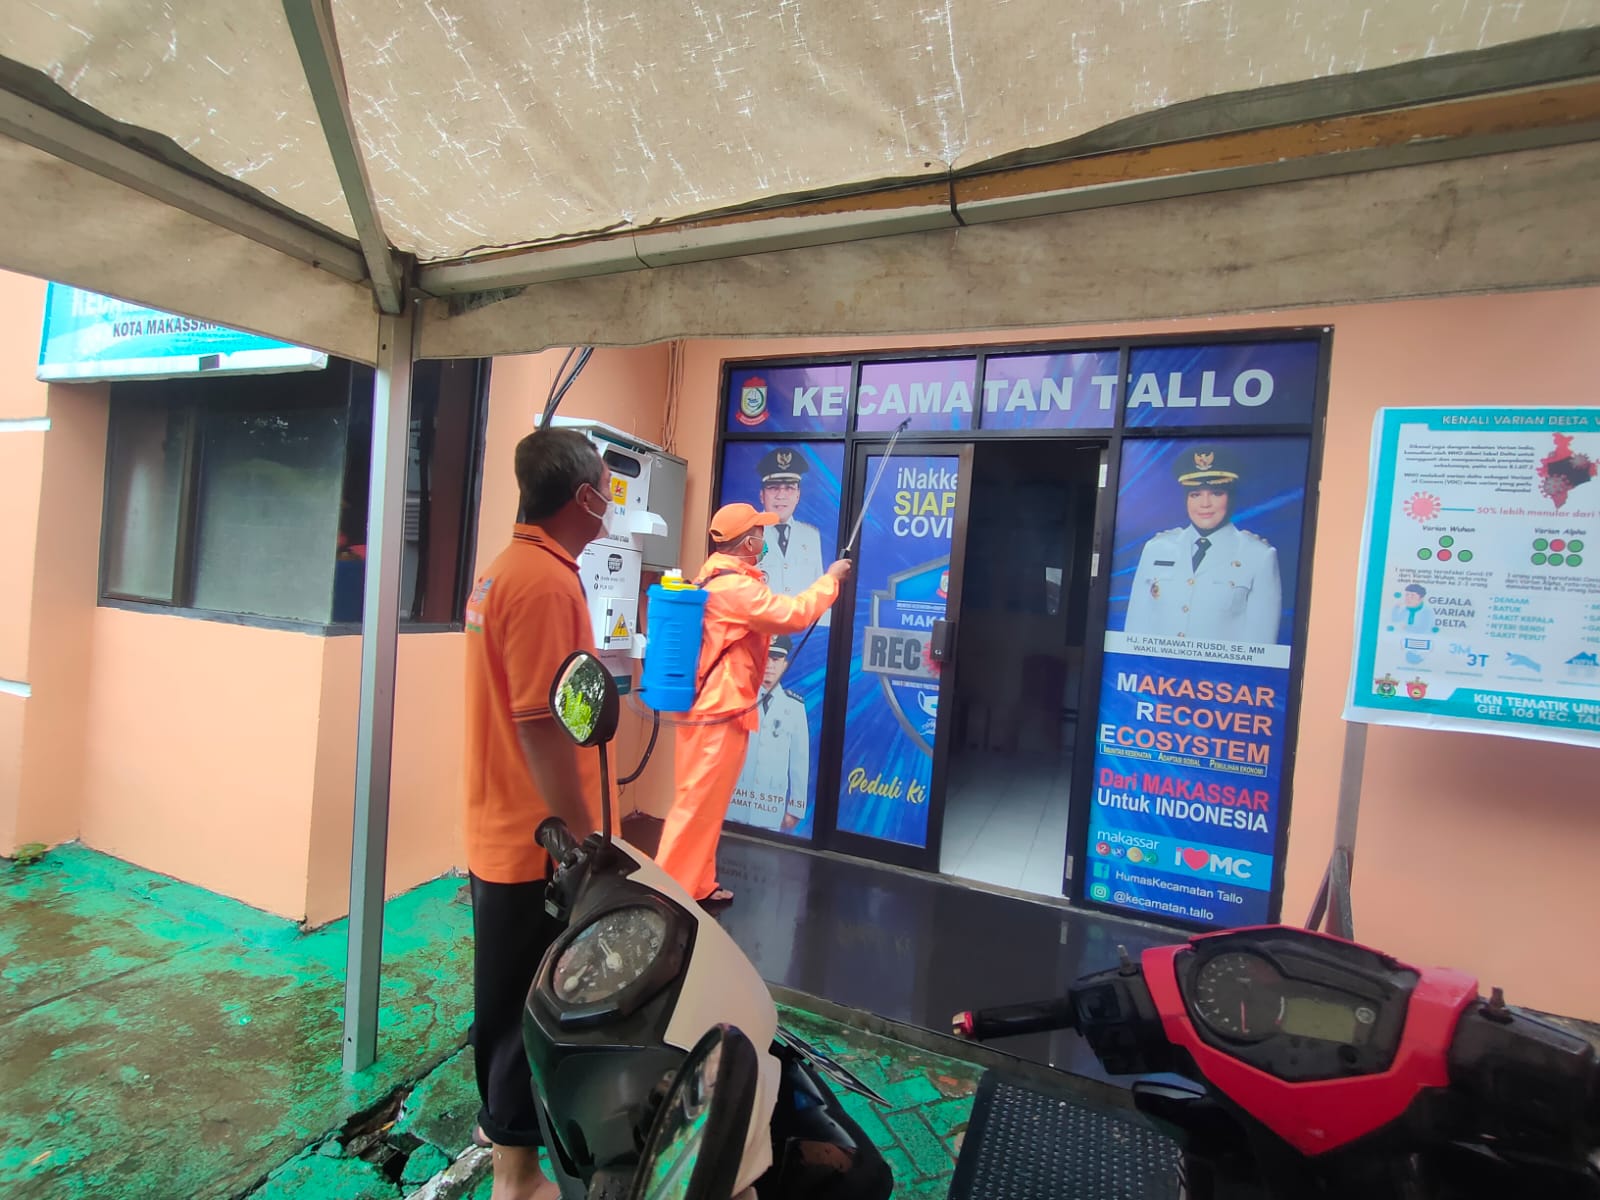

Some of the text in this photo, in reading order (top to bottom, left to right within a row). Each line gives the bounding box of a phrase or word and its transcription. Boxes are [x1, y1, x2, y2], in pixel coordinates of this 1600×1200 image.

[113, 321, 142, 337] KOTA
[793, 369, 1274, 417] KECAMATAN TALLO
[1442, 415, 1588, 426] KENALI VARIAN DELTA
[893, 490, 957, 517] SIAP
[1428, 596, 1472, 607] GEJALA
[901, 613, 945, 629] MAK
[1433, 607, 1475, 619] VARIAN
[1434, 618, 1467, 629] DELTA
[1133, 645, 1254, 662] WAKIL WALIKOTA MAKASSAR
[1142, 637, 1194, 649] FATMAWATI
[1248, 646, 1265, 655] MM
[1466, 653, 1489, 668] 3T
[1117, 672, 1275, 708] MAKASSAR
[1474, 693, 1503, 706] KKN
[1506, 695, 1570, 712] TEMATIK
[1136, 701, 1272, 736] RECOVER
[1511, 707, 1535, 719] 106
[1100, 723, 1269, 764] ECOSYSTEM
[848, 767, 903, 799] Peduli
[1100, 768, 1269, 811] Dari MAKASSAR
[730, 798, 778, 814] AMAT TALLO
[1097, 788, 1269, 833] Untuk INDONESIA
[1097, 830, 1161, 850] makassar
[1115, 869, 1243, 905] HumasKecamatan Tallo
[1113, 889, 1215, 921] @kecamatan.tallo
